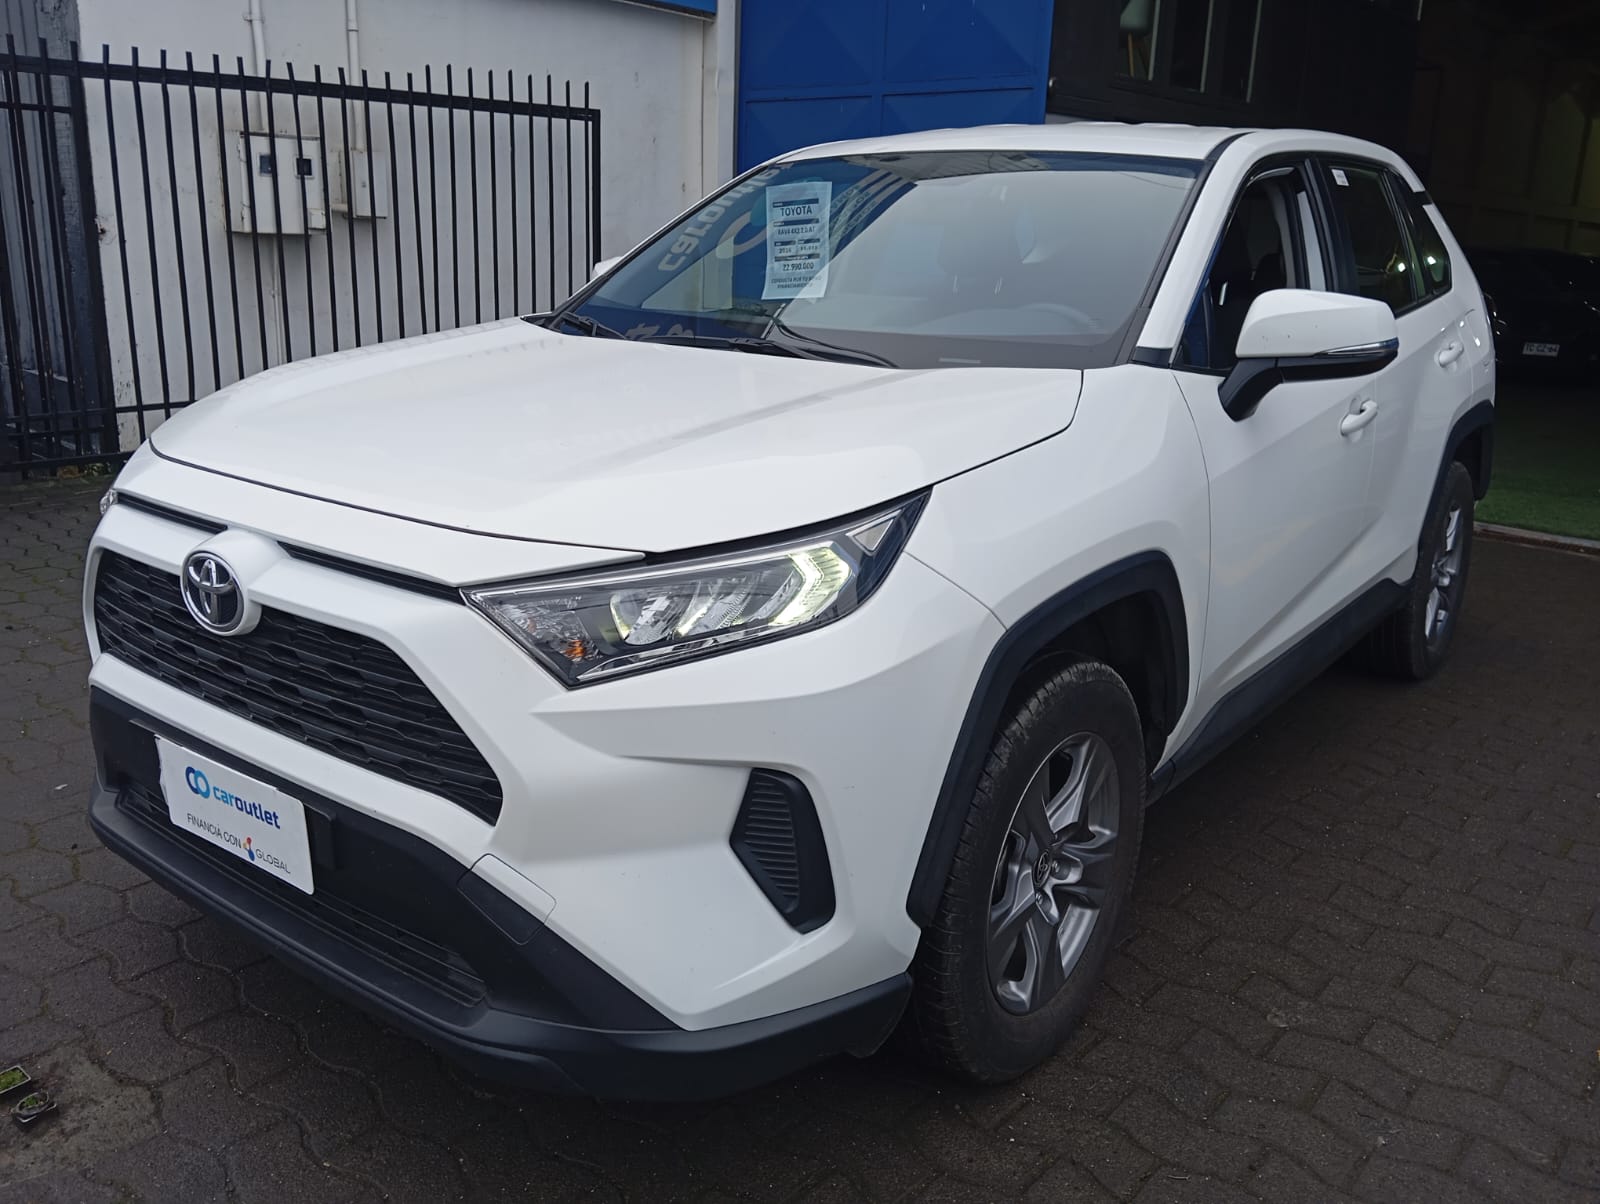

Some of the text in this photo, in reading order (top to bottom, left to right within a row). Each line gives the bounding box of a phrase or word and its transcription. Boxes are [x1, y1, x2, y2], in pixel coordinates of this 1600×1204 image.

[780, 205, 813, 216] TOYOTA
[783, 262, 815, 271] 22.990.000
[212, 785, 281, 830] caroutlet
[223, 832, 242, 849] CON
[255, 848, 291, 874] GLOBAL
